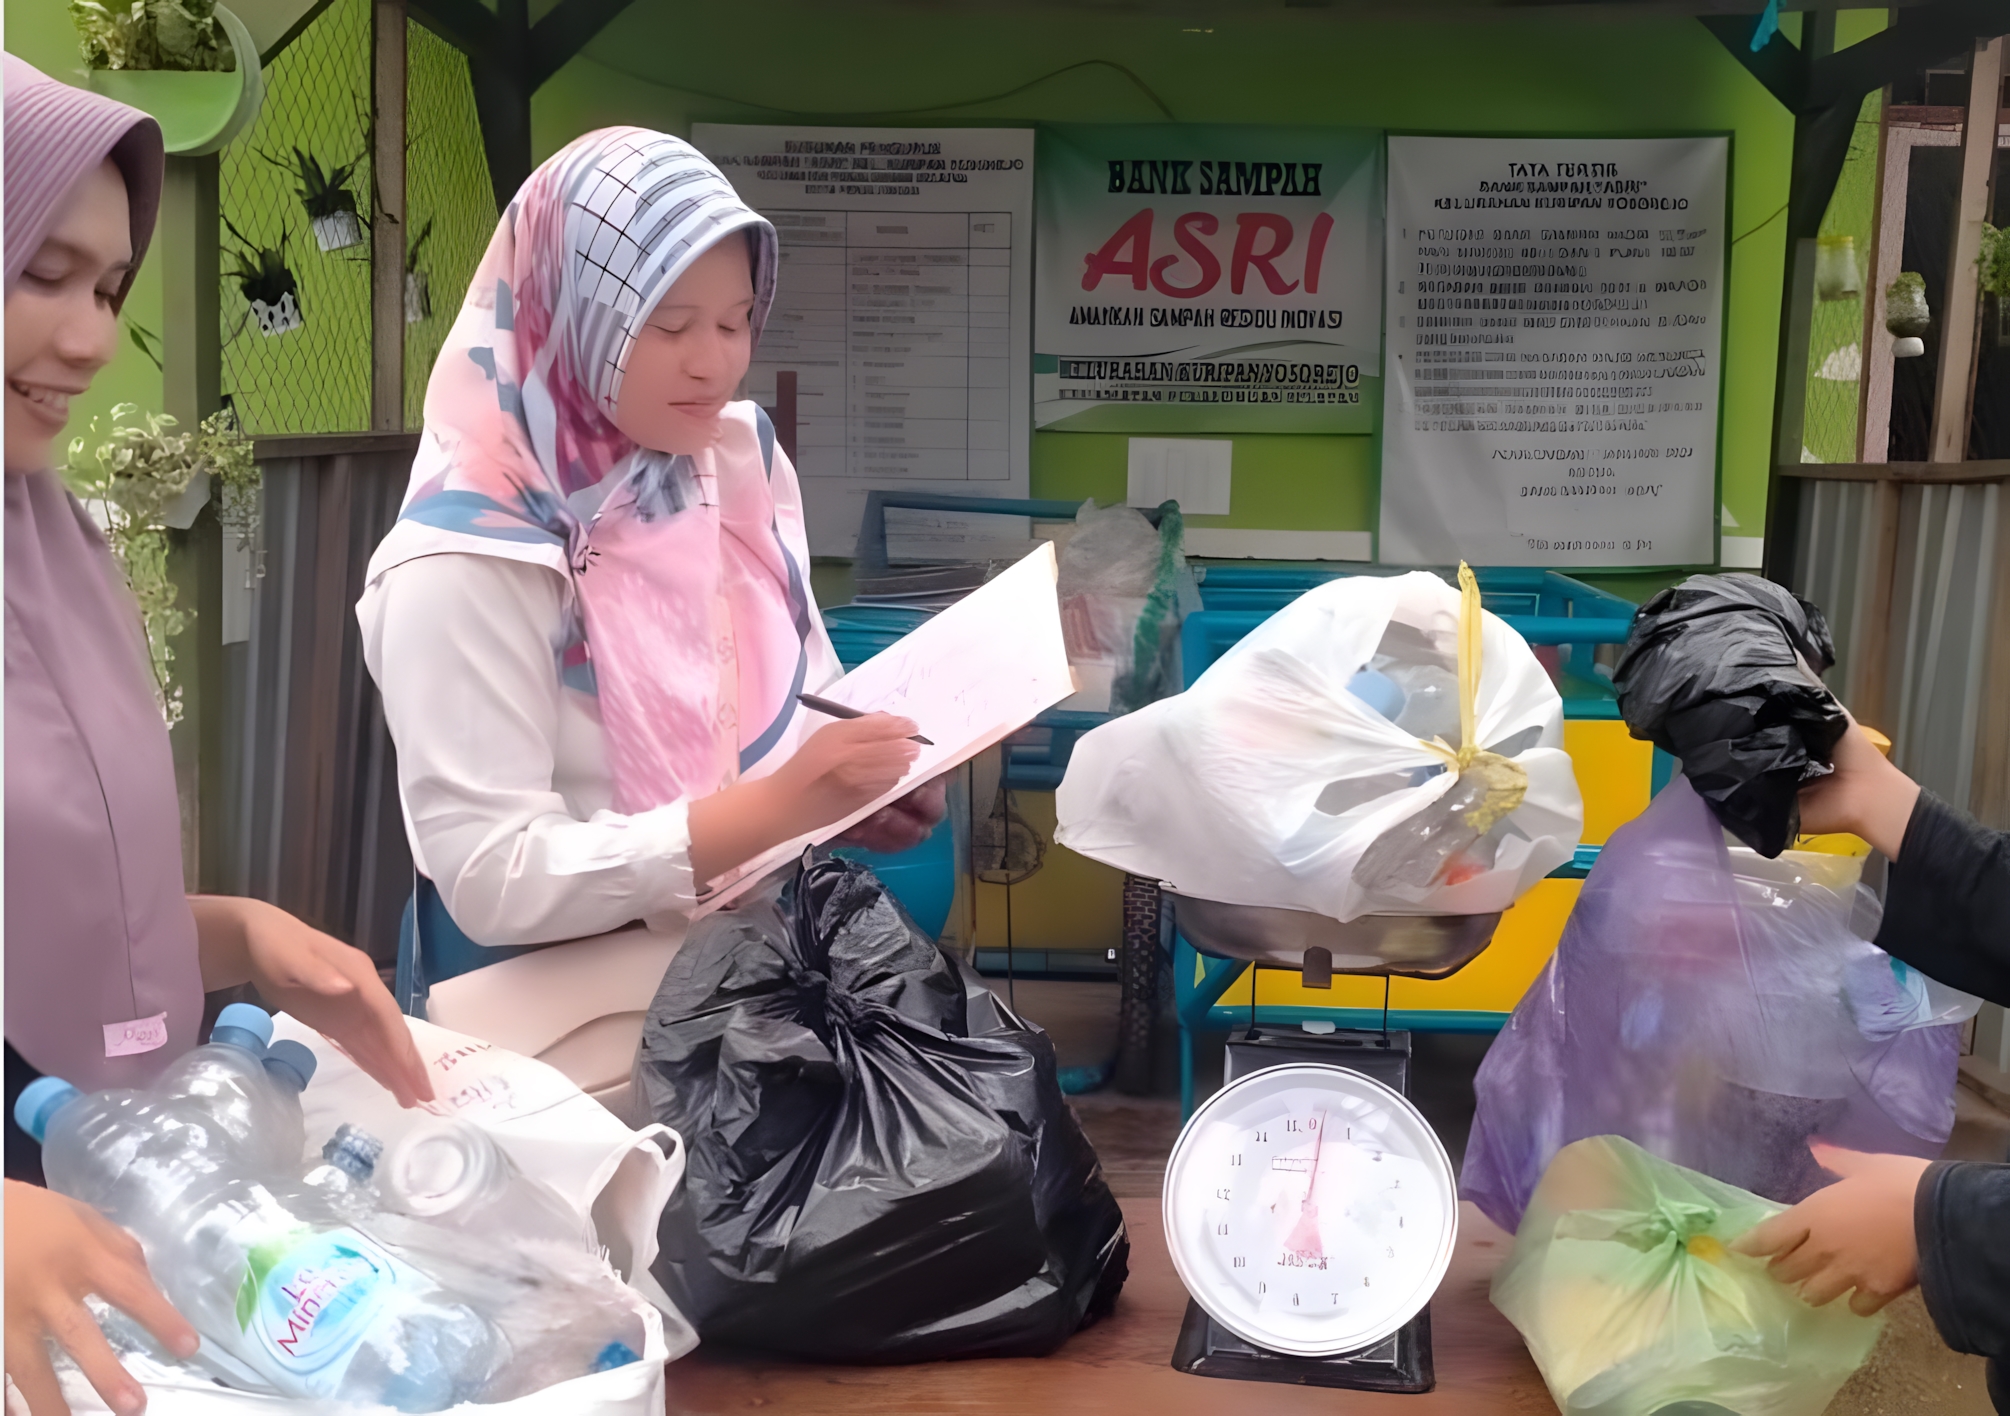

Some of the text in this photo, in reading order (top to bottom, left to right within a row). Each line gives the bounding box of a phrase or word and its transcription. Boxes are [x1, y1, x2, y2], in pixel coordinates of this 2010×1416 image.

[1107, 160, 1323, 197] BANK SAMPAH
[1508, 162, 1550, 178] TATA
[1080, 207, 1335, 299] ASRI
